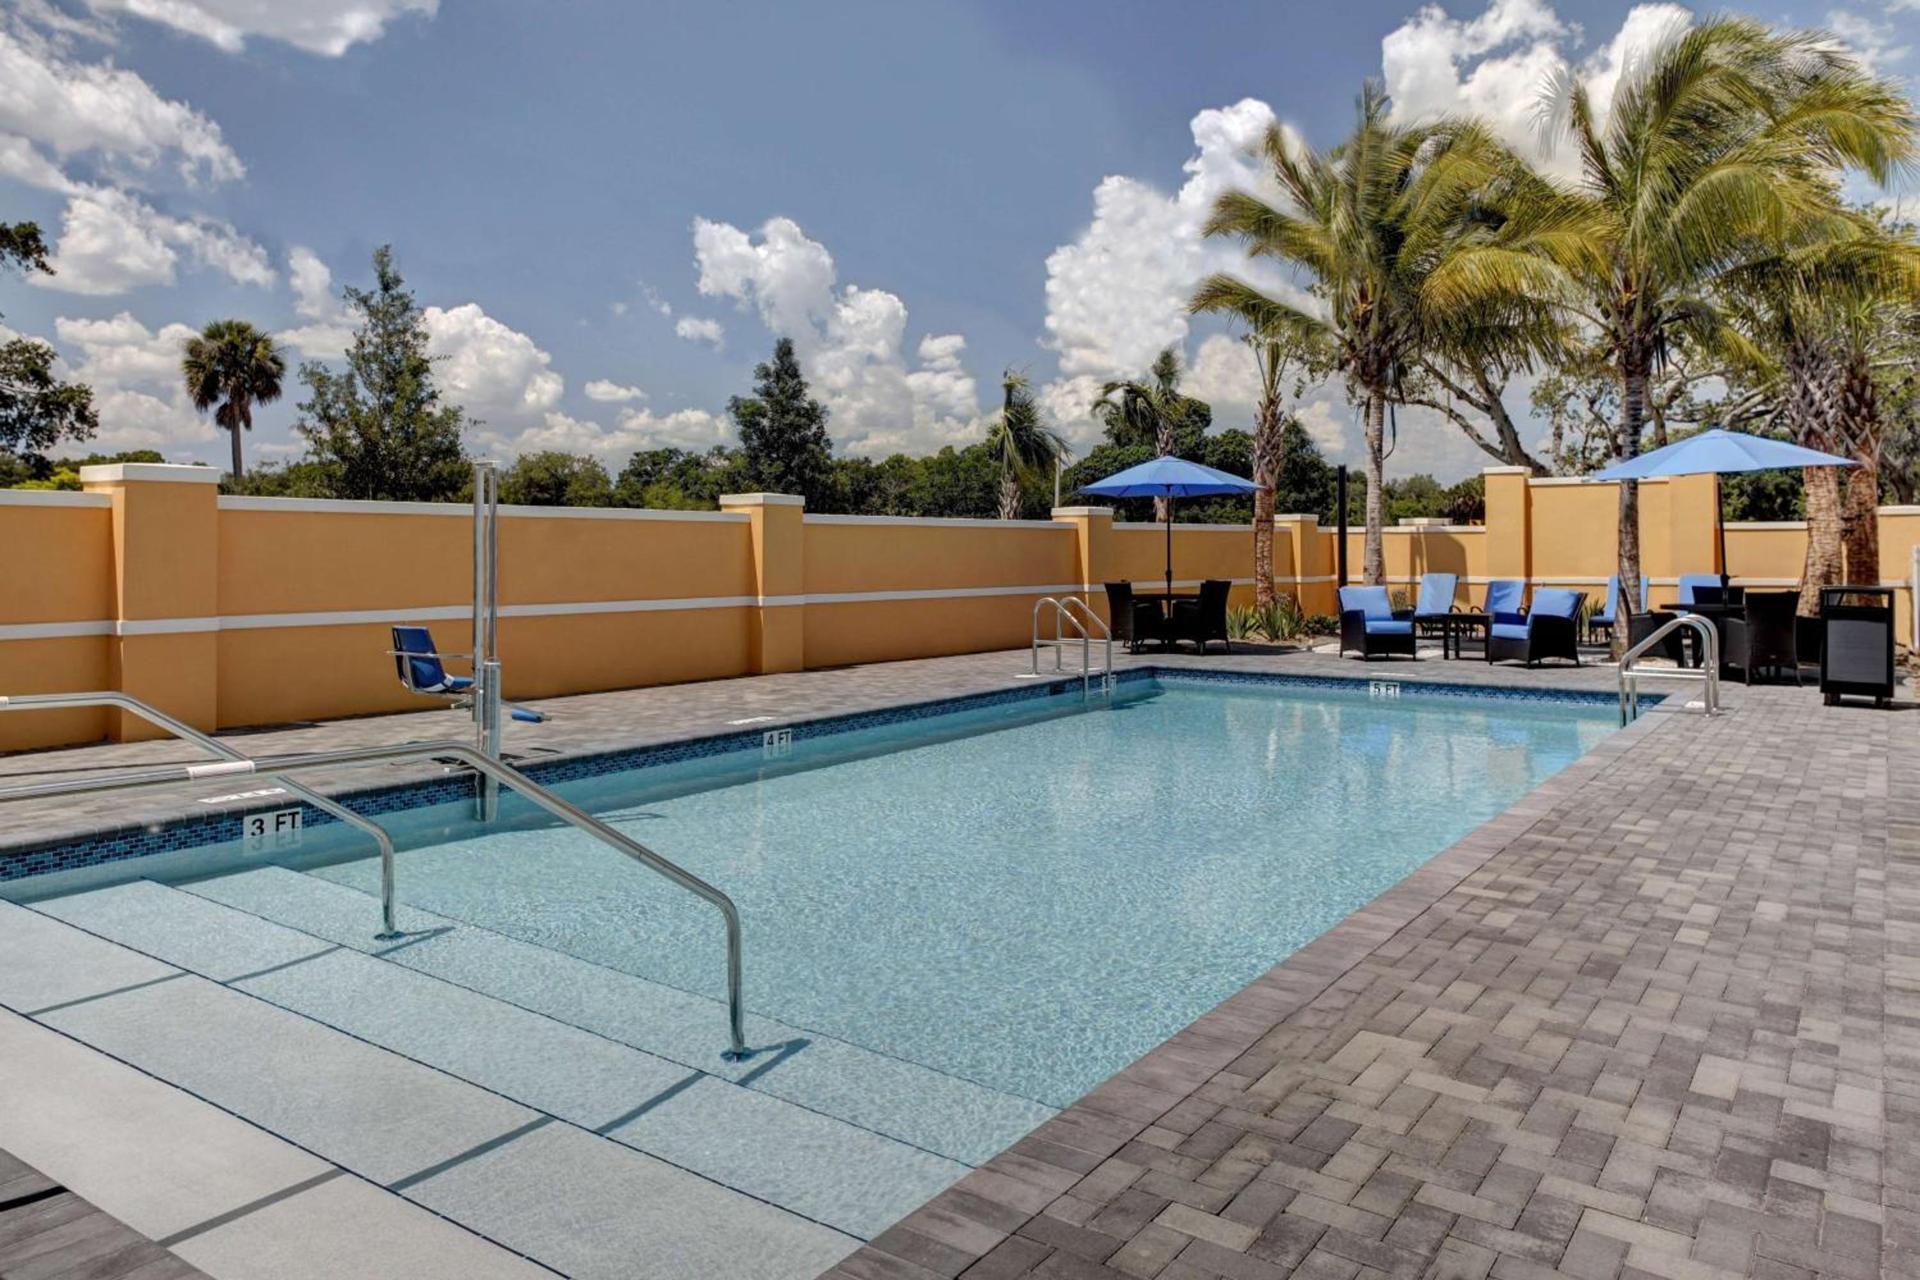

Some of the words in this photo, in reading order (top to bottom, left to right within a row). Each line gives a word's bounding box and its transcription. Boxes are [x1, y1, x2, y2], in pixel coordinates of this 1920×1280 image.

[1386, 684, 1398, 696] FT
[767, 733, 774, 745] 4
[778, 731, 790, 744] FT
[251, 818, 264, 836] 3
[275, 811, 300, 832] FT
